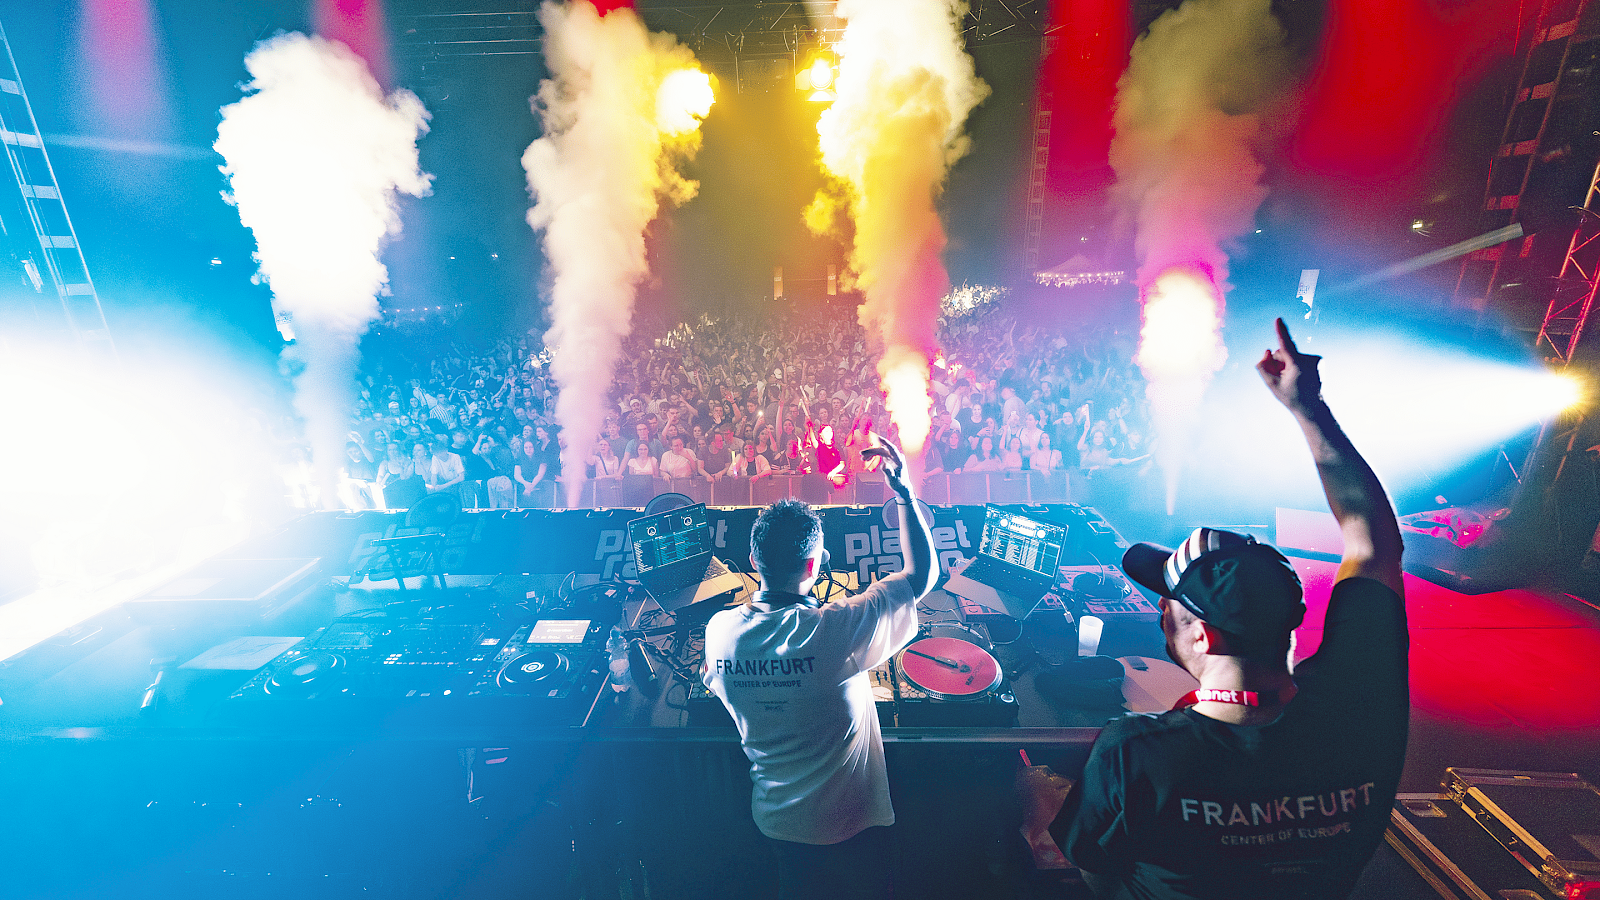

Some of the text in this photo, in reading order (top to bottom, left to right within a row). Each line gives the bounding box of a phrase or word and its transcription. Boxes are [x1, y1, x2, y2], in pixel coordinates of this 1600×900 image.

[845, 520, 971, 564] plaet
[716, 656, 815, 675] FRANKFURT
[733, 680, 760, 688] CENTER
[772, 680, 802, 688] EUROPE
[1180, 782, 1374, 827] FRANKFURT
[1221, 822, 1351, 845] CENTER OF EUROPE
